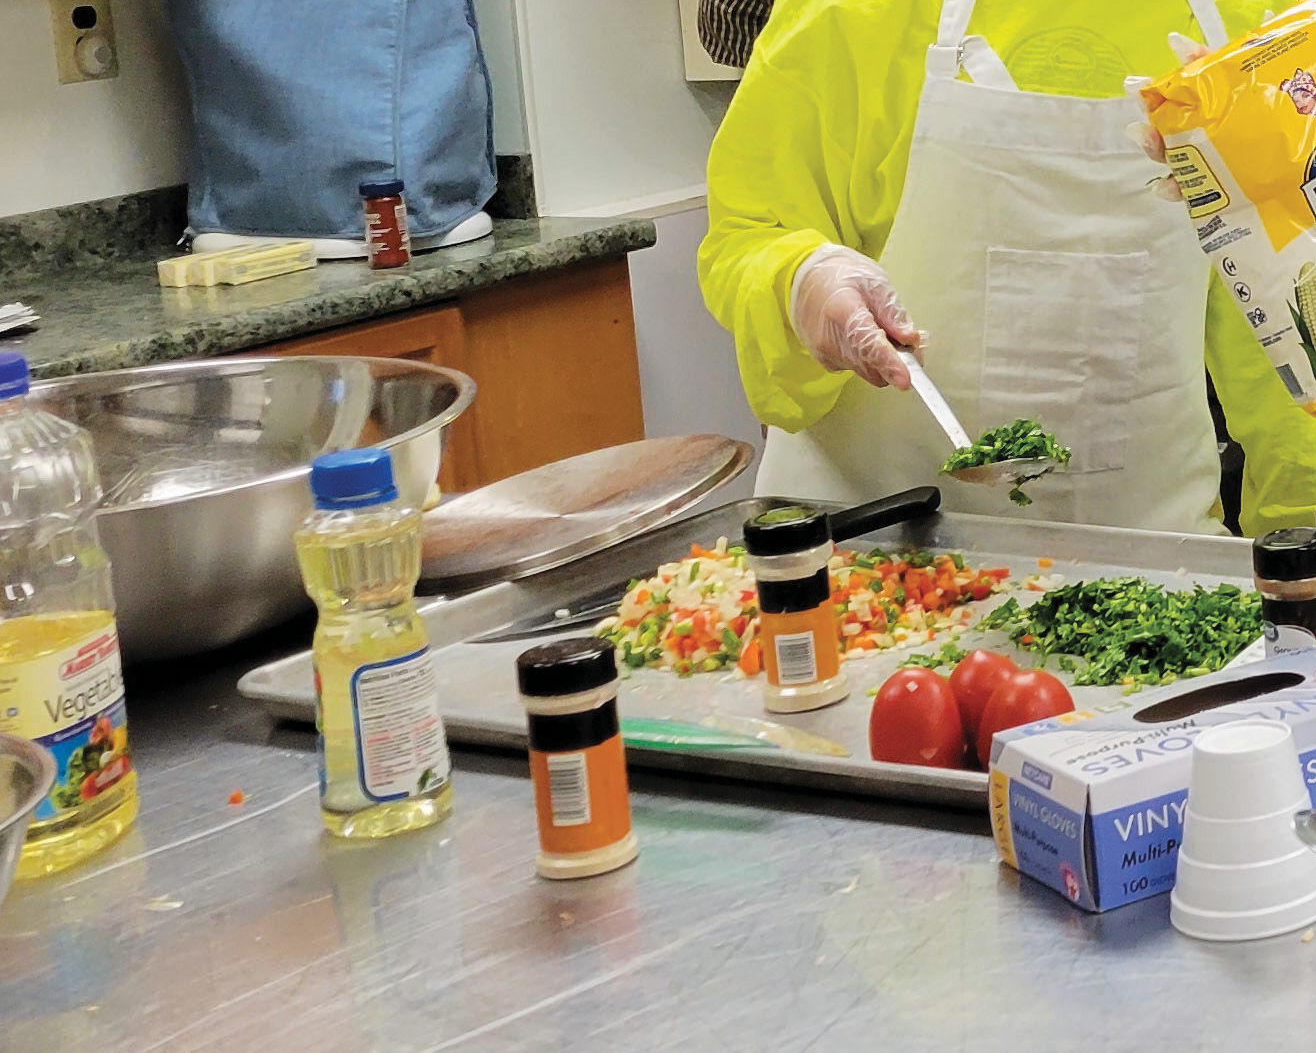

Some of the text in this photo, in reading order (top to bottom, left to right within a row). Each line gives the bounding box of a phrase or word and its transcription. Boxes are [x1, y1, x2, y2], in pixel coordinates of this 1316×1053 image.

[1065, 718, 1197, 765] Multi-Purpose
[1081, 732, 1201, 777] OVES
[1113, 798, 1188, 842] VINY
[1122, 876, 1149, 896] 100
